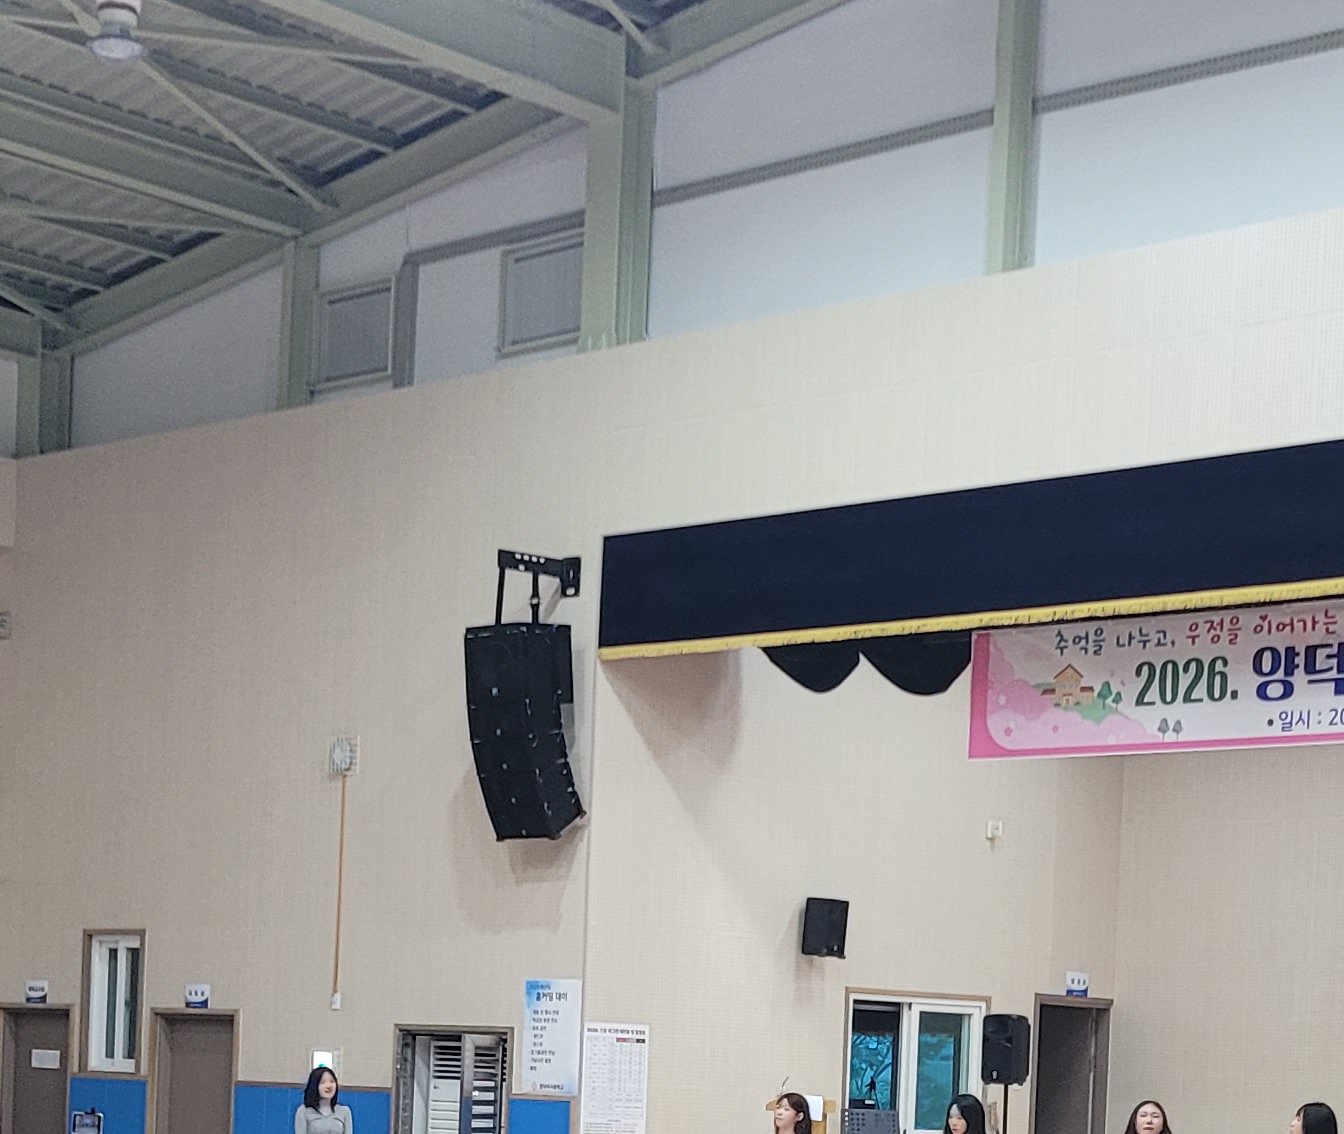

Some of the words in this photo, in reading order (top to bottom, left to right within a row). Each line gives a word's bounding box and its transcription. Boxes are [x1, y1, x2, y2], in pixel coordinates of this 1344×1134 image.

[1055, 626, 1106, 656] 추억을
[1115, 626, 1176, 649] 나누고,
[1186, 615, 1242, 646] 우정을
[1252, 607, 1338, 637] 이어가는
[1134, 655, 1239, 707] 2026.
[1277, 709, 1312, 733] 일시
